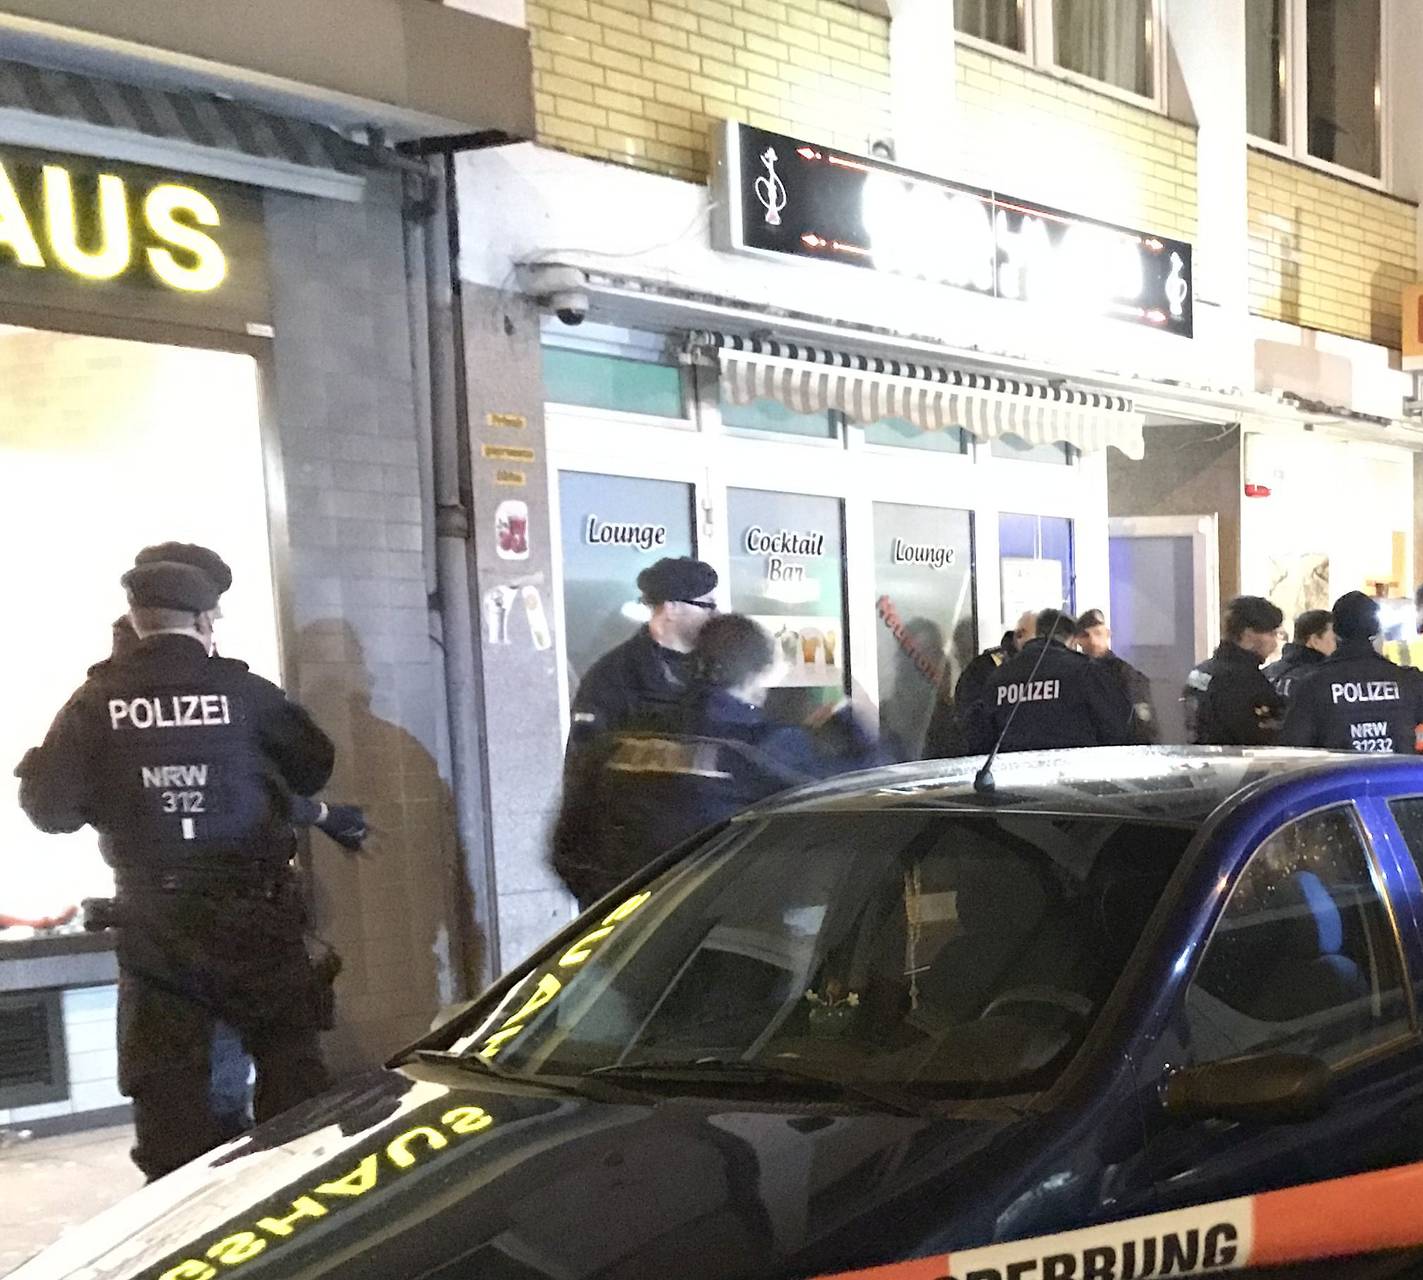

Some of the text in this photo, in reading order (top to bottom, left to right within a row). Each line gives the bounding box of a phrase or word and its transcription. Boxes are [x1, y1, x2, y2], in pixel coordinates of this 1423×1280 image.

[588, 518, 666, 550] Lounge
[748, 527, 824, 556] Cocktail
[896, 539, 954, 567] Lounge
[769, 558, 804, 582] Bar
[997, 679, 1060, 706] POLIZEI
[1331, 681, 1400, 704] POLIZEI
[108, 695, 231, 730] POLIZEI
[1350, 721, 1388, 738] NRW
[141, 764, 208, 788] NRW
[161, 791, 205, 813] 312
[934, 1222, 1238, 1280] RRUNG
